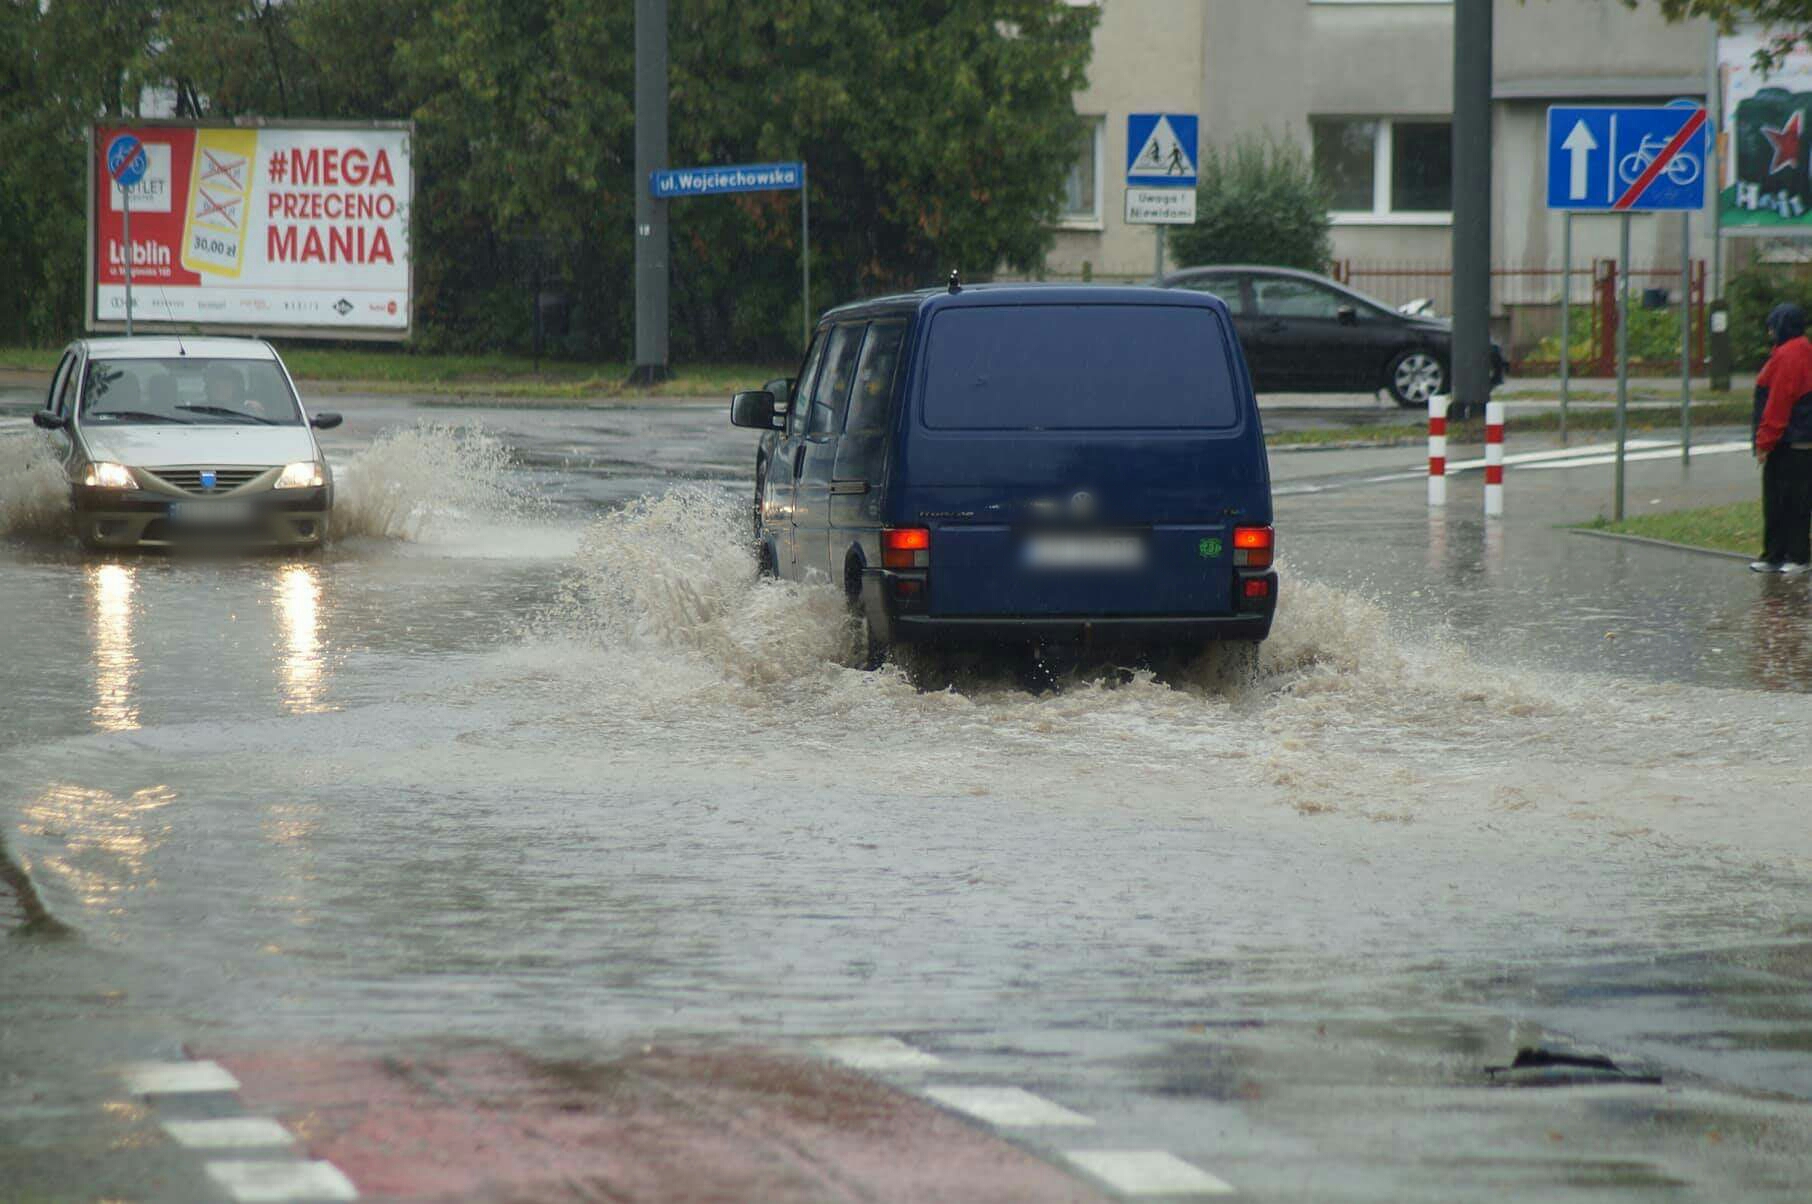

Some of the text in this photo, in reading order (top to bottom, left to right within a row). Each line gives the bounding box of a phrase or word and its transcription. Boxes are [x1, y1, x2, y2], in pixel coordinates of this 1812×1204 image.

[268, 147, 395, 187] #MEGA
[660, 168, 795, 192] ul. Wojciechowska
[268, 192, 396, 220] PRZECENO
[109, 239, 171, 265] Lublin
[193, 236, 225, 255] 30,00
[267, 225, 394, 264] MANIA
